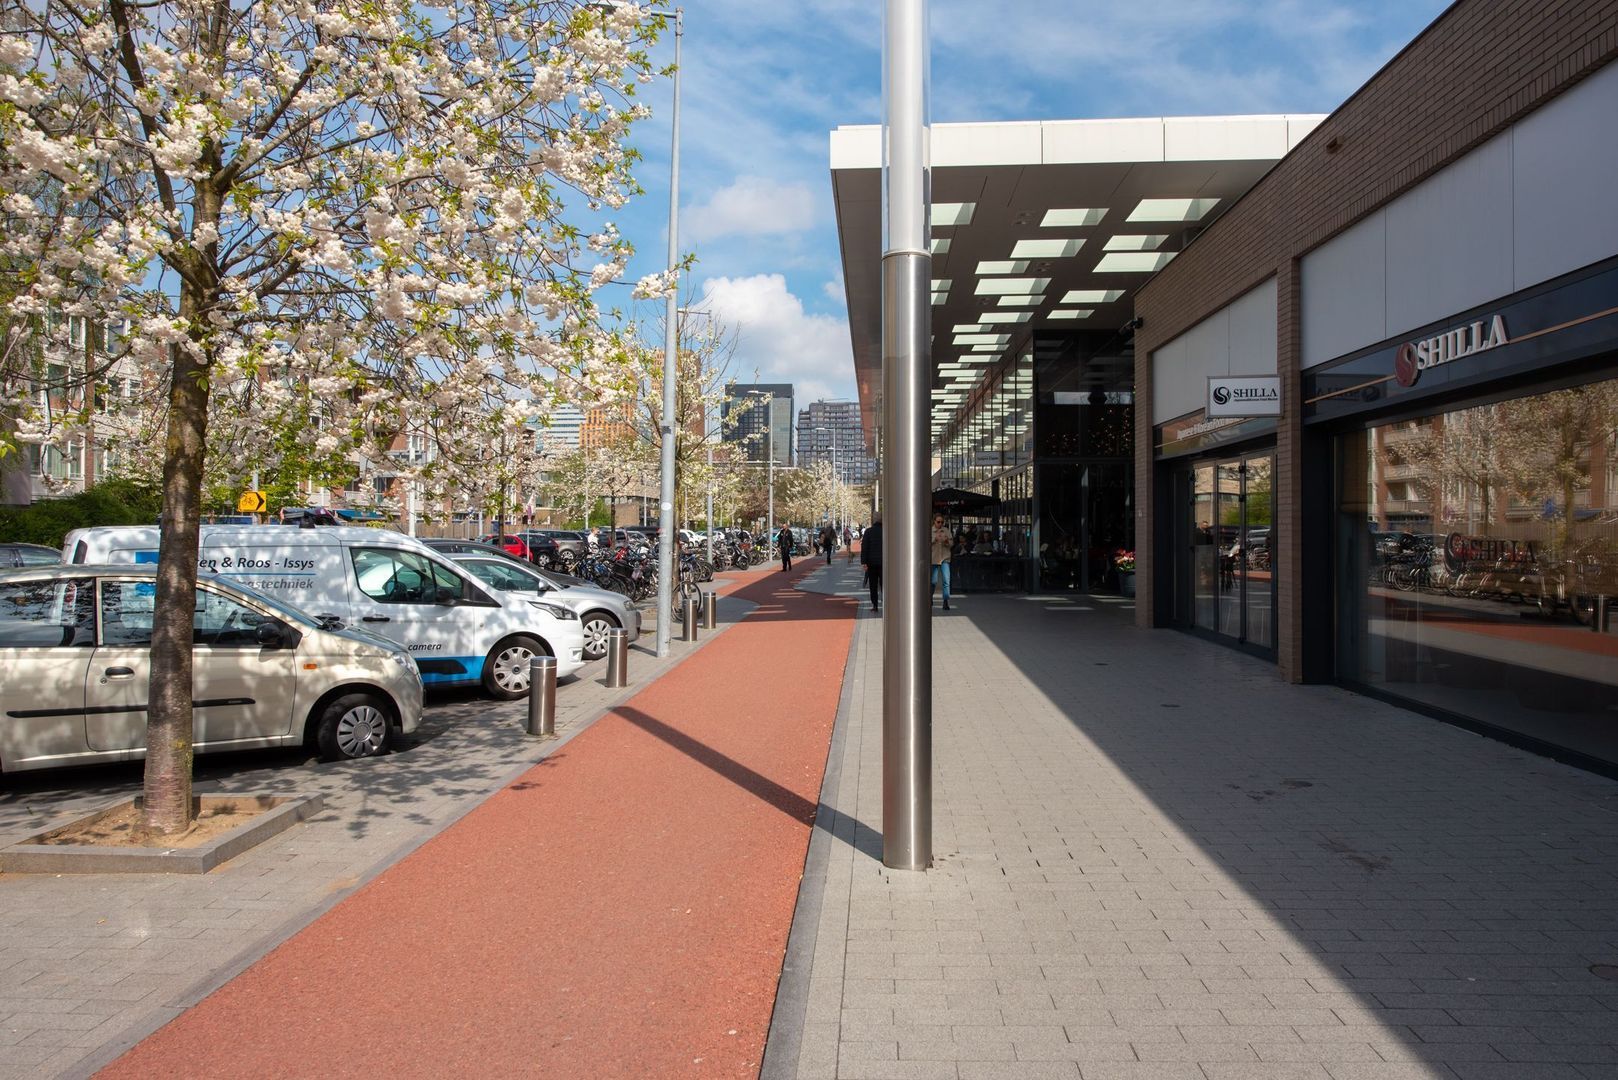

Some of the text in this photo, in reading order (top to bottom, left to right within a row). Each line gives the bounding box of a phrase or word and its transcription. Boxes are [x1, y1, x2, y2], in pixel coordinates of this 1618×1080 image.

[1417, 315, 1509, 370] SHILLA
[1233, 388, 1278, 397] SHILLA
[197, 559, 216, 569] en
[221, 556, 232, 569] &
[237, 557, 271, 569] Roos
[283, 557, 314, 571] Issys
[407, 643, 442, 651] camera
